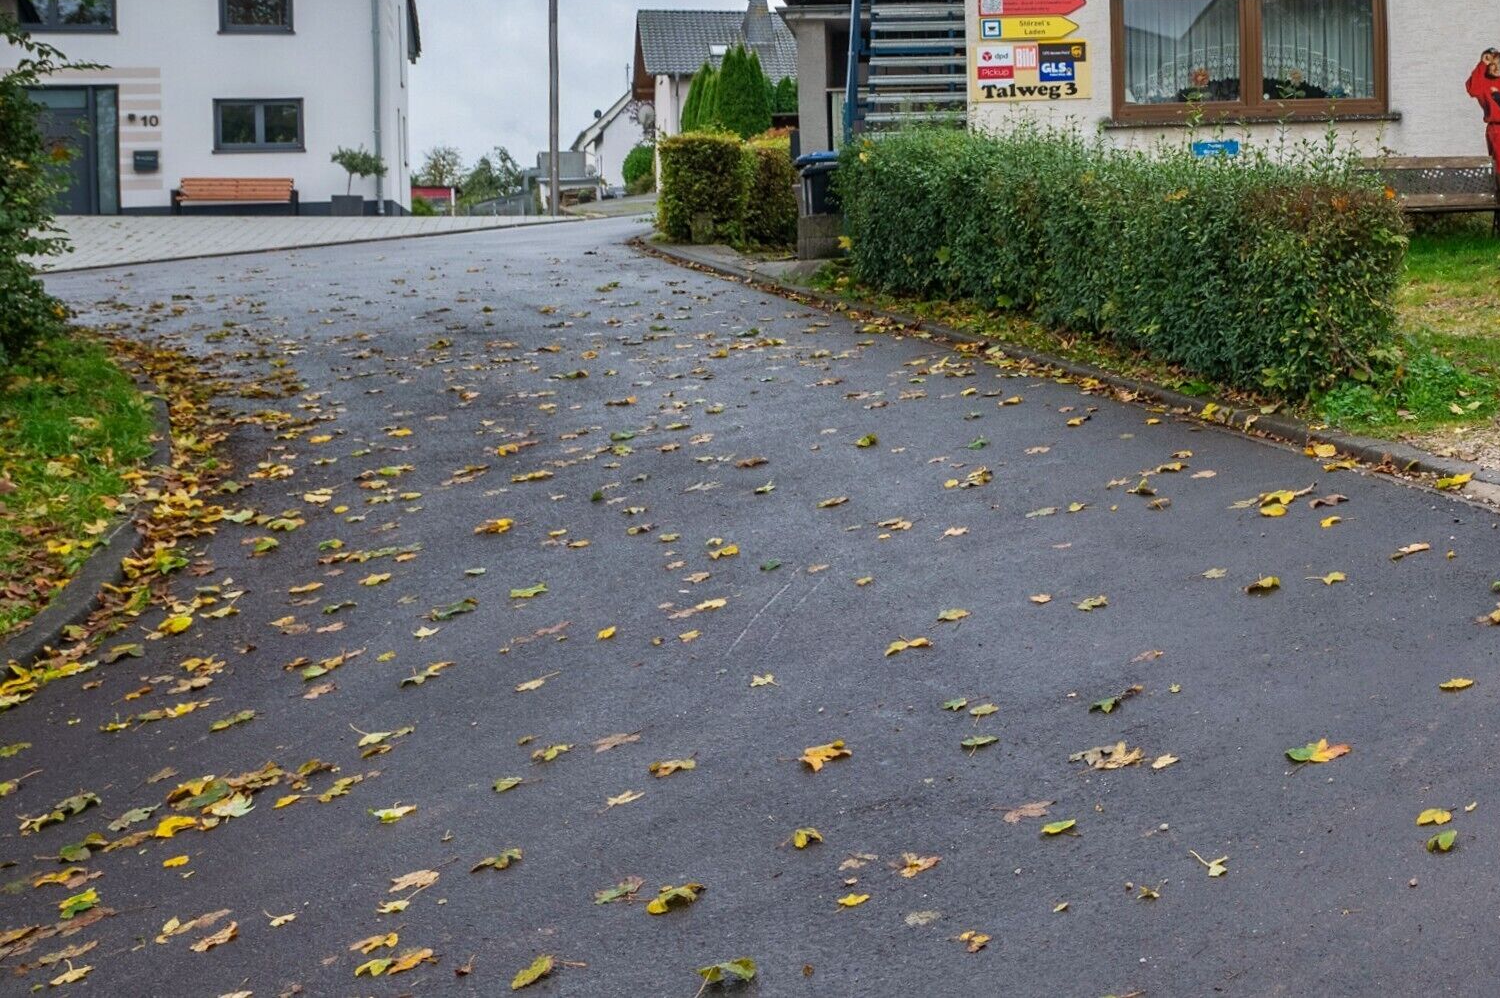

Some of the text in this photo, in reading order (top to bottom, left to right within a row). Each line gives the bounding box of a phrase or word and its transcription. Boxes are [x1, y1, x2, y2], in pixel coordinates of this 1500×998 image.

[994, 52, 1009, 60] dpd
[981, 68, 1010, 77] Pickup
[1041, 62, 1067, 73] GLS
[981, 82, 1078, 99] Talweg 3
[141, 115, 159, 127] 10
